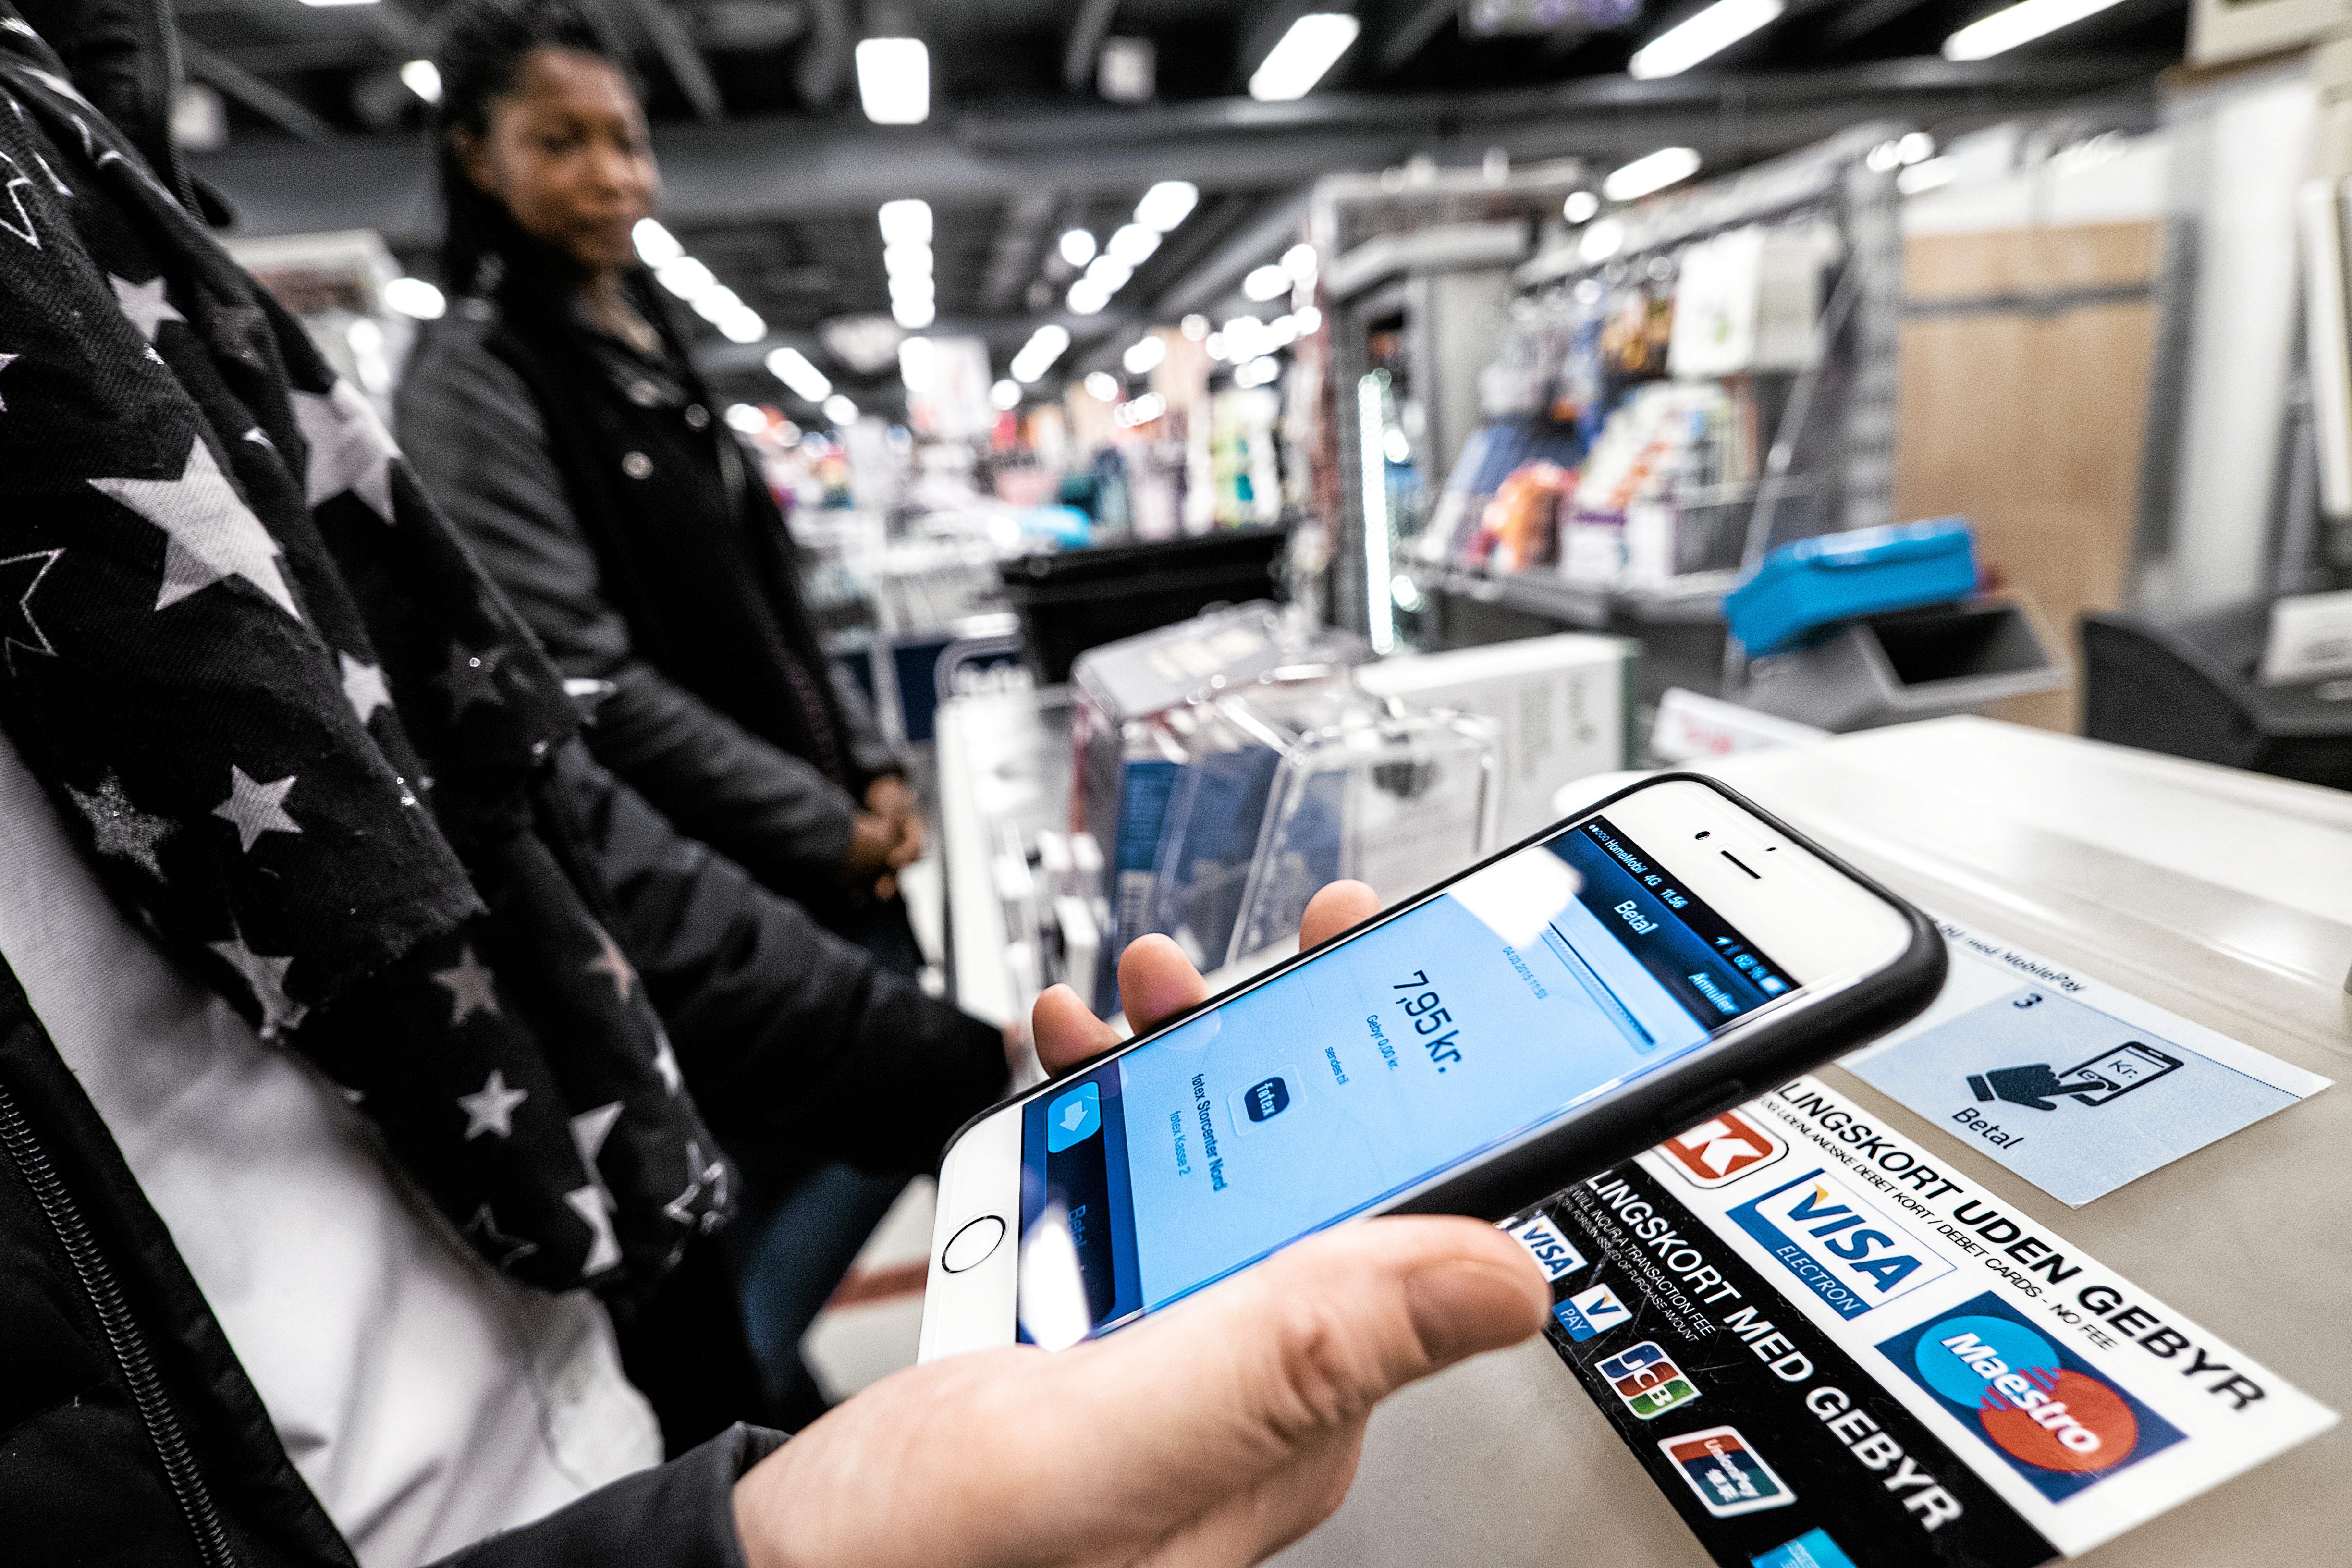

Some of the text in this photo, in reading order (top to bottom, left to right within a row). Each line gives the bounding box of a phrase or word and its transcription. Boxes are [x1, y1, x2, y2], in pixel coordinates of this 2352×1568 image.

[1605, 839, 1648, 874] HomeMobil
[1644, 875, 1662, 886] 4G
[1614, 900, 1659, 935] Betal
[1688, 972, 1740, 1014] Annuller
[1999, 951, 2087, 992] MobilePay
[1393, 969, 1462, 1073] 7,95 kr.
[2012, 992, 2043, 1009] 3
[1366, 1015, 1384, 1038] Gebyr
[1325, 1046, 1343, 1076] sendes
[1174, 1134, 1187, 1167] Kasse
[1197, 1100, 1218, 1158] Storcenter
[1208, 1157, 1228, 1192] Nord
[1952, 1107, 2025, 1151] Betal
[1179, 1166, 1191, 1176] 2
[1523, 1225, 1574, 1275] VISA
[1772, 1083, 2268, 1412] LINGSKORT UDEN GEBYR
[1787, 1183, 1923, 1293] VISA
[1853, 1164, 1898, 1192] DEBET
[1892, 1192, 1935, 1219] KORT
[1936, 1224, 1990, 1257] DEBET
[1985, 1258, 2043, 1298] CARDS
[2049, 1304, 2081, 1324] NO
[2079, 1324, 2121, 1351] FEE
[1589, 1209, 1622, 1242] INCUR
[1628, 1243, 1695, 1315] TRANSACTION
[1688, 1313, 1716, 1336] FEE
[1776, 1245, 1862, 1311] ELECTRON
[1560, 1308, 1588, 1331] PAY
[1627, 1269, 1668, 1309] PURCHASE
[1662, 1309, 1700, 1342] AMOUNT
[1585, 1169, 1963, 1533] LINGSKORT MED GEBYR
[1618, 1357, 1674, 1407] JCB
[1939, 1332, 2101, 1453] Maestro
